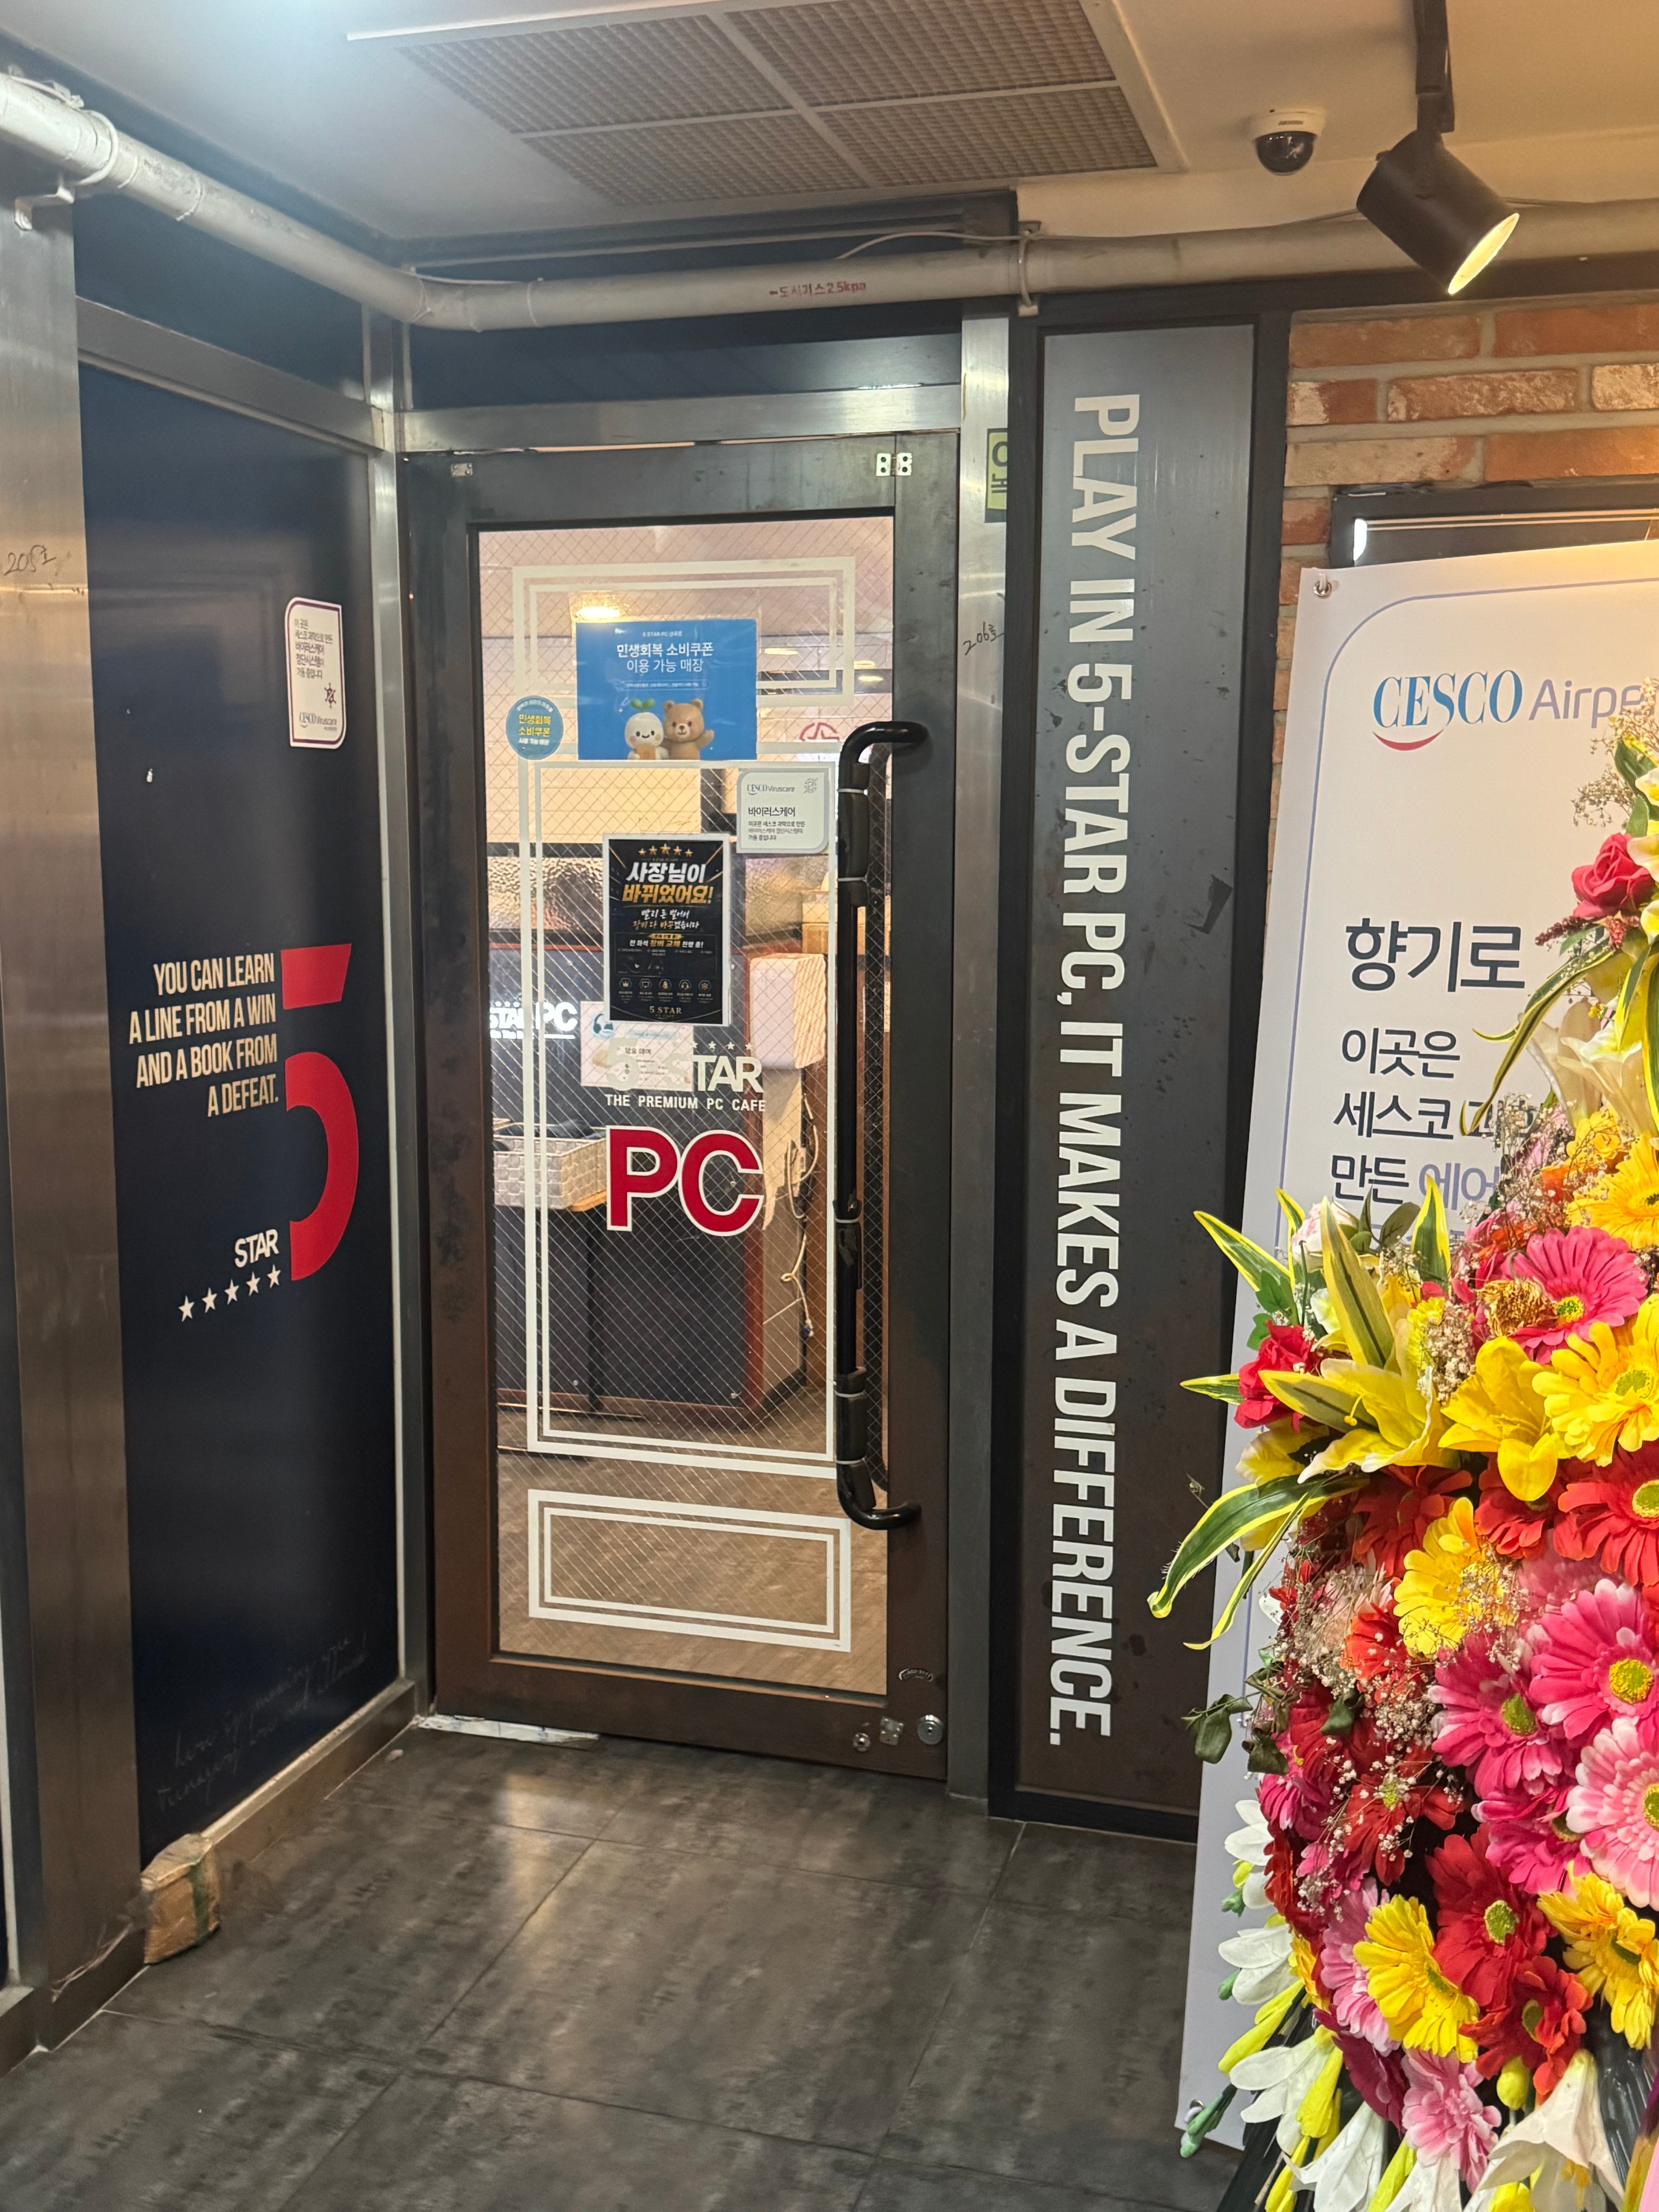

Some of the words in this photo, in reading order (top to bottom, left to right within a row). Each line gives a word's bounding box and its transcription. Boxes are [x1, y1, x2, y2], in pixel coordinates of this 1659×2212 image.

[1071, 394, 1139, 560] PLAY
[1069, 579, 1135, 643] IN
[617, 643, 664, 658] 민생회복
[666, 642, 714, 657] 소비쿠폰
[627, 659, 650, 673] 이용
[653, 658, 677, 673] 가능
[680, 658, 704, 672] 매장
[519, 714, 551, 725] 민생회복
[1373, 670, 1523, 728] CESCO
[1529, 679, 1659, 729] Airpe
[519, 727, 550, 737] 소비쿠폰
[1063, 663, 1132, 894] 5-STAR
[748, 807, 795, 817] 바이러스케어
[622, 884, 714, 904] 바뀌었어요!
[626, 862, 706, 884] 사장님이
[153, 961, 187, 996] YOU
[190, 957, 224, 992] CAN
[226, 953, 275, 988] LEARN
[1057, 913, 1126, 1005] PC,
[1345, 918, 1525, 993] 향기로
[129, 1011, 143, 1044] A
[145, 1004, 183, 1043] LINE
[185, 999, 231, 1036] FROM
[233, 997, 245, 1029] A
[246, 993, 276, 1027] WIN
[136, 1051, 172, 1089] AND
[176, 1048, 188, 1081] A
[190, 1041, 233, 1076] BOOK
[235, 1033, 278, 1070] FROM
[1060, 1022, 1123, 1077] IT
[1341, 1027, 1460, 1078] 이곳은
[207, 1085, 220, 1117] A
[221, 1074, 280, 1115] DEFEAT.
[604, 1094, 630, 1107] THE
[638, 1095, 698, 1109] PREMIUM
[706, 1098, 724, 1110] PC
[732, 1099, 766, 1112] CAFE
[1333, 1091, 1454, 1140] 세스코
[606, 1125, 765, 1237] PC
[1056, 1092, 1121, 1307] MAKES
[1331, 1155, 1410, 1204] 만든
[234, 1229, 279, 1268] STAR
[1055, 1319, 1117, 1360] A
[1049, 1377, 1116, 1745] DIFFERENCE.
